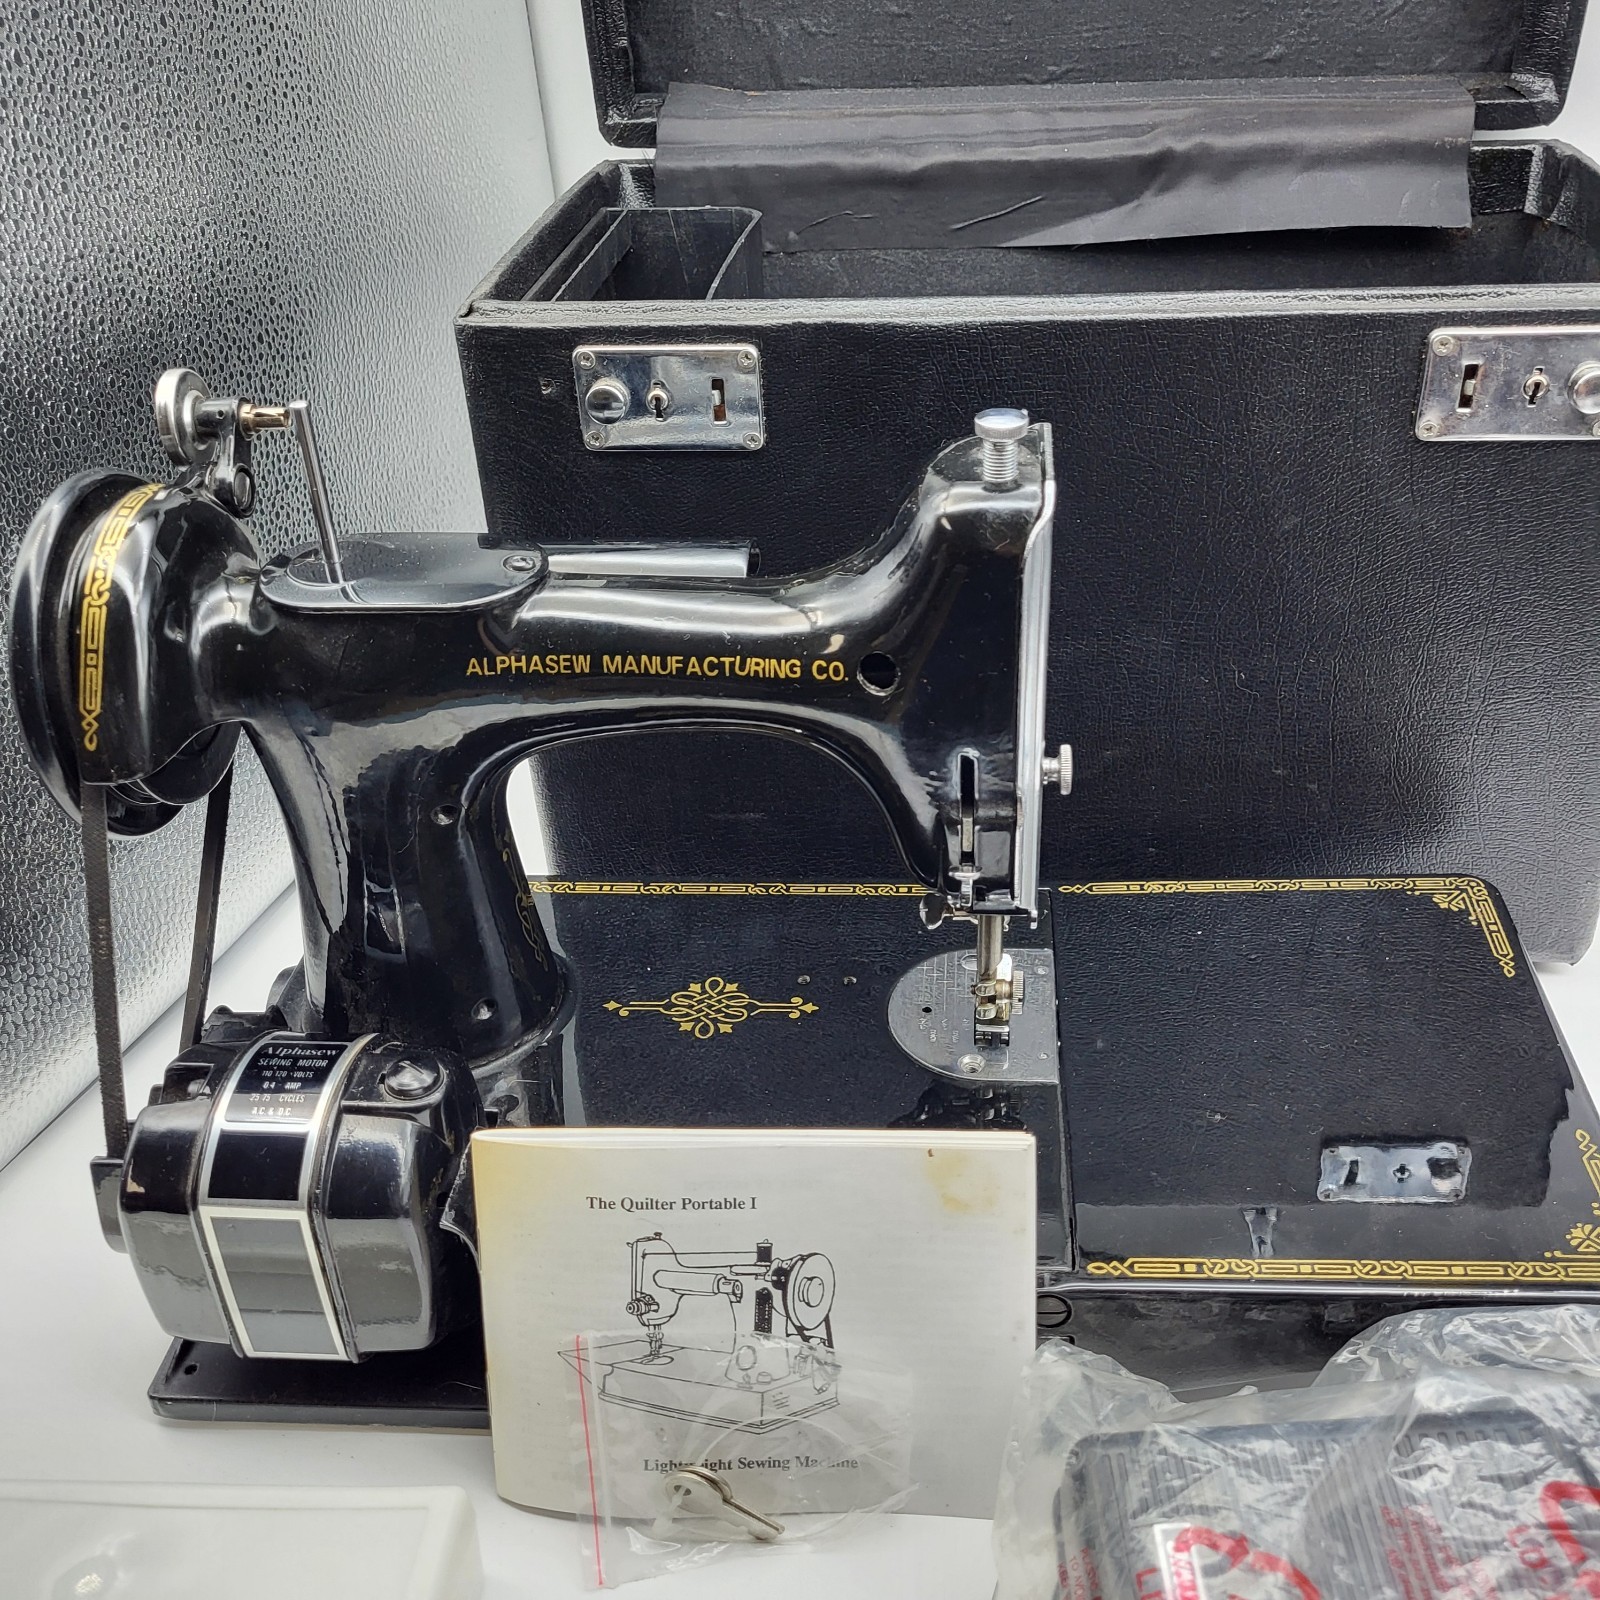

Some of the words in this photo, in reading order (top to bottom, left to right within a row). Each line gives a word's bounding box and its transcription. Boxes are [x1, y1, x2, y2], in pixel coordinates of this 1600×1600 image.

[466, 654, 591, 676] ALPHASEW
[602, 654, 801, 679] MANUFACTURING
[811, 659, 849, 682] CO.
[261, 1046, 340, 1056] Alphasew
[257, 1057, 293, 1066] SEWING
[296, 1059, 329, 1067] MOTOR
[284, 1082, 302, 1090] AMP
[278, 1094, 305, 1103] CYCLES
[586, 1196, 616, 1210] The
[620, 1196, 676, 1213] Quilter
[681, 1197, 746, 1210] Portable
[750, 1196, 758, 1210] I
[644, 1458, 733, 1474] Lighight
[737, 1456, 790, 1471] Sewing
